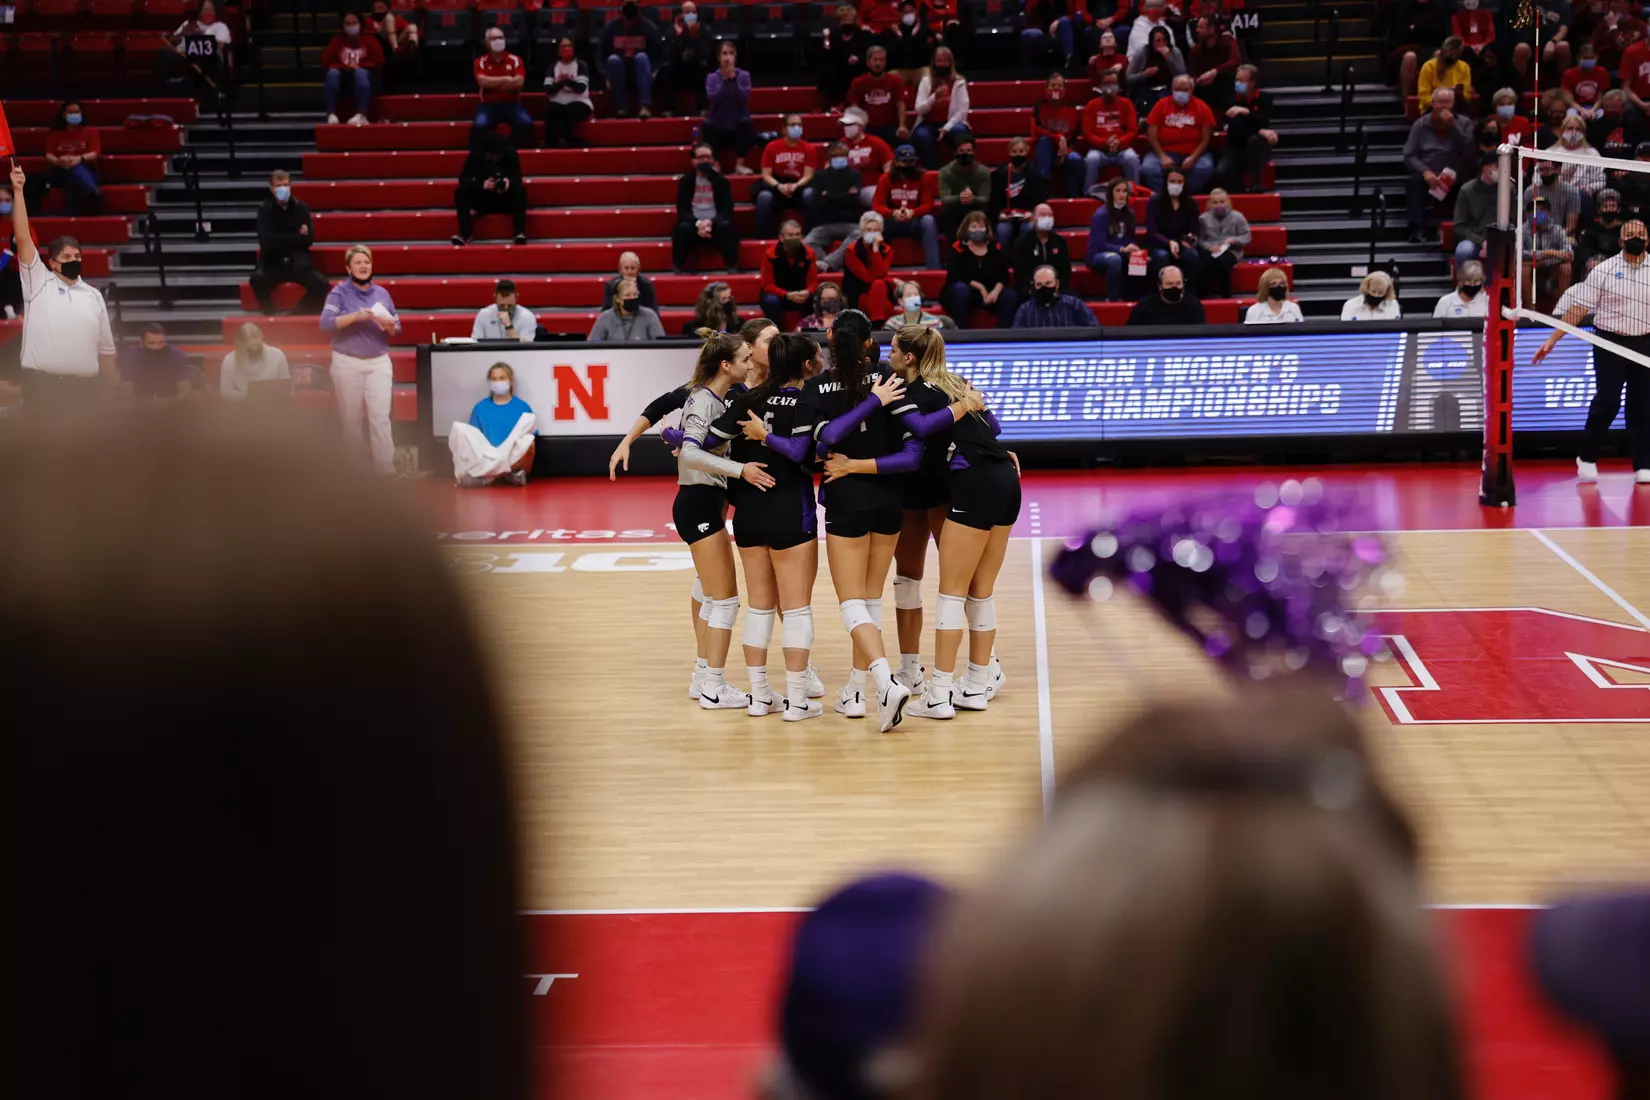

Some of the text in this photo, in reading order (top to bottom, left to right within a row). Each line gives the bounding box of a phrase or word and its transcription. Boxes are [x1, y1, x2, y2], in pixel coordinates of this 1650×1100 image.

[1231, 13, 1259, 29] A14
[188, 40, 213, 56] A13
[1010, 358, 1136, 388] DIVISION
[1161, 354, 1298, 385] WOMEN'S
[552, 364, 609, 420] N
[1081, 384, 1341, 421] CHAMPIONSHIPS
